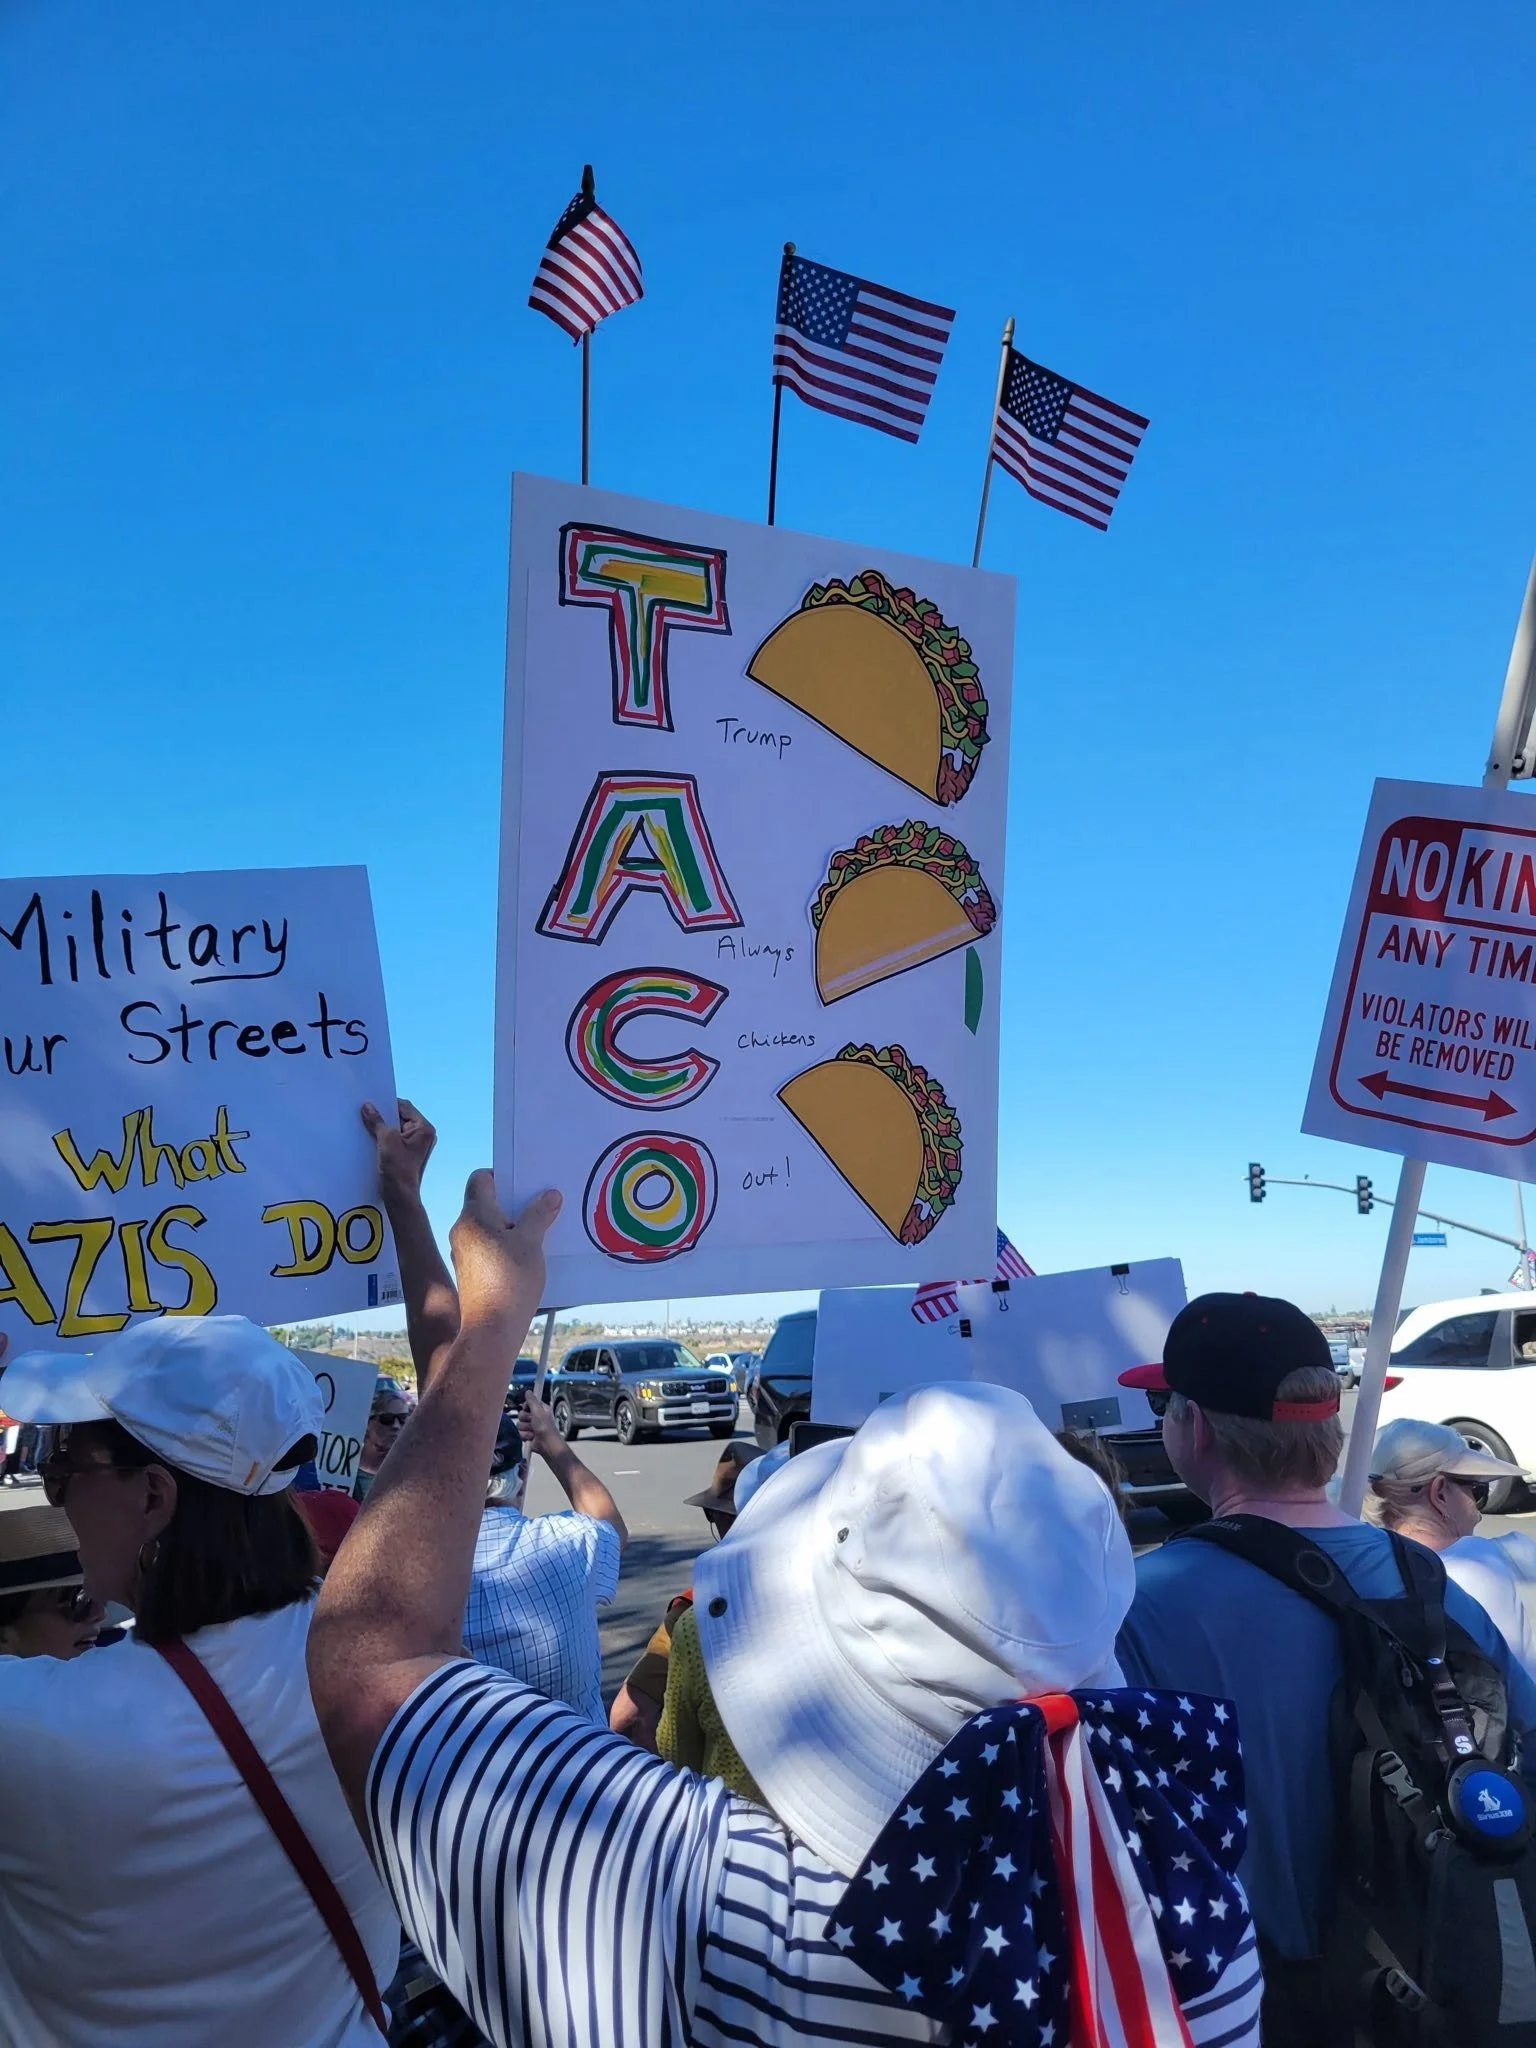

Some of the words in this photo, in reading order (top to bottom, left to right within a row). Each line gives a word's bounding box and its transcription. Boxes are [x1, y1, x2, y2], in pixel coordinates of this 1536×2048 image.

[716, 718, 793, 759] Trump
[1380, 837, 1450, 903] NO
[0, 889, 288, 985] Military
[717, 936, 795, 977] Always
[1377, 924, 1455, 969] ANY
[1469, 935, 1536, 983] TIM
[120, 992, 369, 1064] Streets
[1362, 992, 1487, 1041] VIOLATORS
[1491, 1015, 1536, 1051] WIL
[1375, 1030, 1402, 1061] BE
[1409, 1037, 1514, 1082] REMOVED
[52, 1105, 250, 1194] What
[261, 1200, 384, 1277] DO
